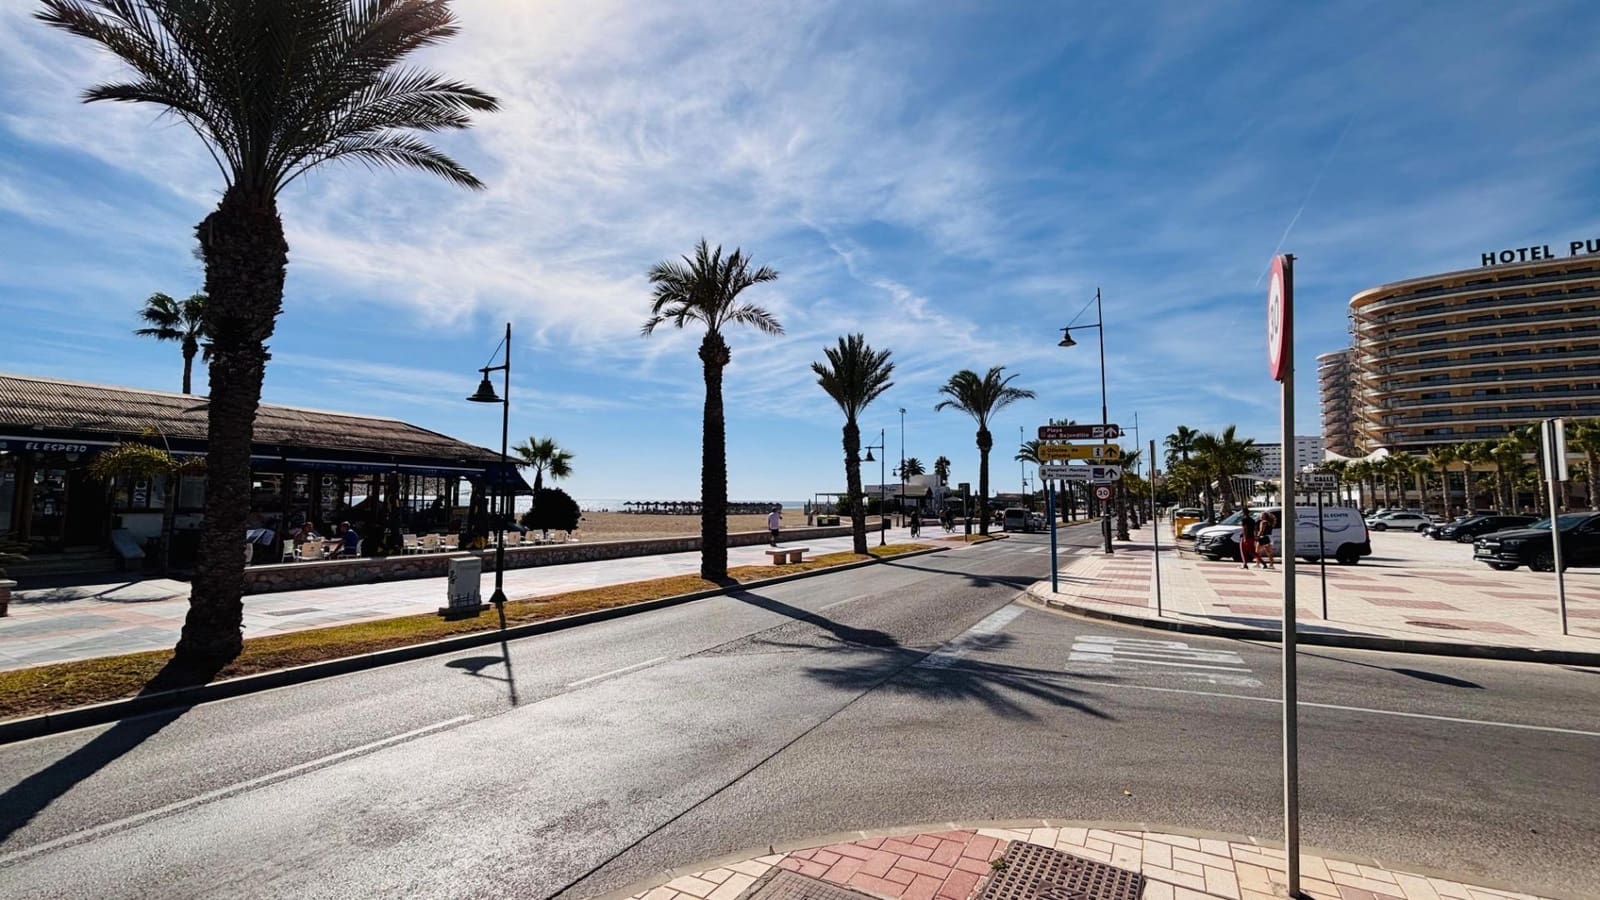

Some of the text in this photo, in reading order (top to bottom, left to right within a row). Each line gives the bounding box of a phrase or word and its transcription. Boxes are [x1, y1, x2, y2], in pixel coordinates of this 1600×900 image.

[1482, 239, 1600, 265] HOTEL PU
[25, 442, 88, 453] EL ESPETO
